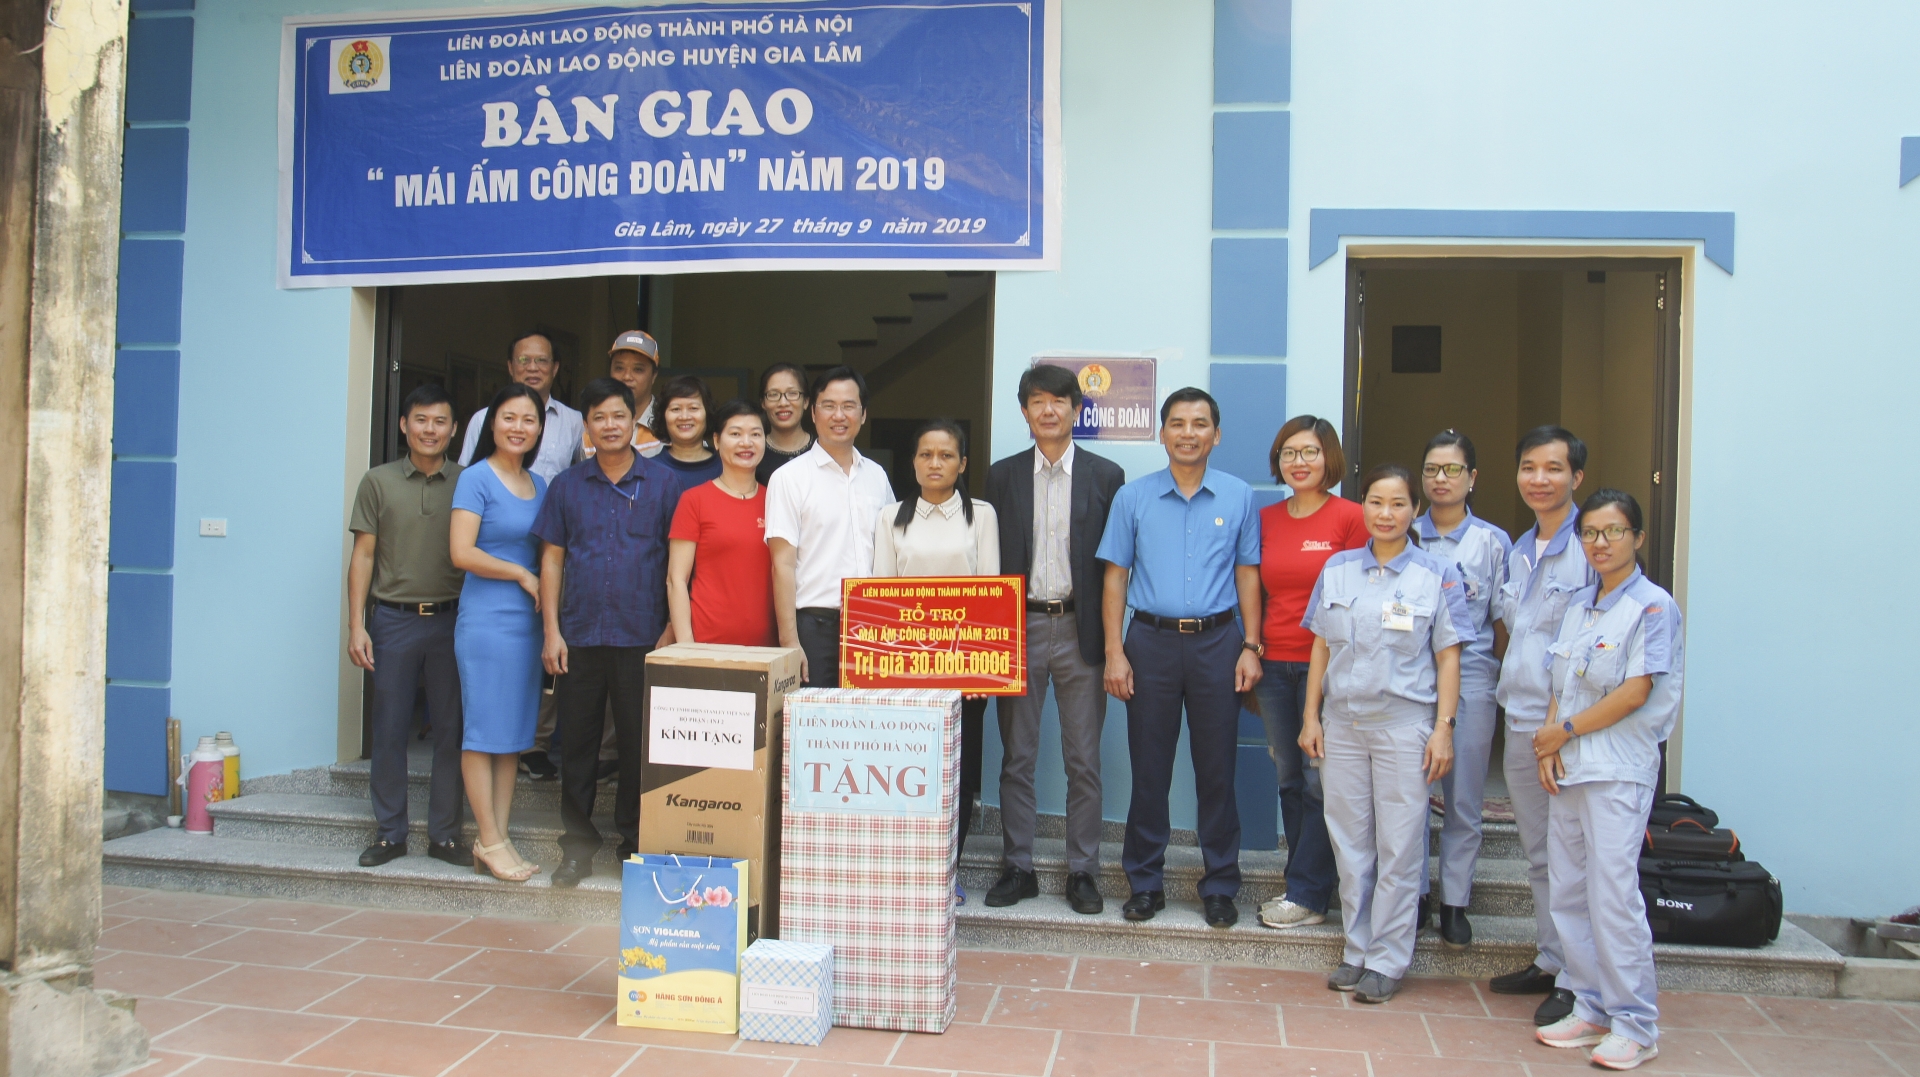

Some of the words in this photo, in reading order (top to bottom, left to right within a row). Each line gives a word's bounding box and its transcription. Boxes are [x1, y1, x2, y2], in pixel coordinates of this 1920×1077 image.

[448, 34, 484, 52] LIÊN
[489, 29, 545, 48] ĐOÀN
[551, 28, 588, 44] LAO
[594, 22, 652, 44] ĐỘNG
[658, 18, 725, 37] THÀNH
[732, 13, 774, 34] PHỐ
[780, 14, 809, 34] HÀ
[816, 14, 852, 36] NỘI
[440, 60, 481, 81] LIÊN
[488, 54, 552, 78] ĐOÀN
[559, 54, 600, 73] LAO
[608, 47, 676, 72] ĐỘNG
[683, 44, 756, 68] HUYỆN
[764, 46, 806, 64] GIA
[814, 41, 862, 63] LÂM
[482, 84, 620, 148] BÀN
[638, 88, 814, 138] GIAO
[395, 166, 456, 208] MÁI
[466, 158, 518, 204] ẤM
[530, 159, 618, 200] CÔNG
[758, 150, 843, 192] NĂM
[856, 157, 945, 191] 2019
[614, 222, 646, 238] Gia
[651, 220, 695, 240] Lâm,
[702, 218, 752, 236] ngày
[755, 218, 783, 234] 27
[792, 218, 853, 236] tháng
[857, 218, 872, 234] 9
[882, 218, 927, 234] năm
[932, 218, 986, 234] 2019
[1084, 402, 1115, 428] CÔNG
[1118, 404, 1150, 428] ĐOÀN
[862, 586, 878, 598] LIÊN
[880, 586, 900, 598] ĐOÀN
[901, 588, 914, 597] LAO
[916, 586, 936, 598] ĐỘNG
[937, 585, 960, 597] THÀNH
[962, 584, 976, 597] PHỐ
[978, 586, 988, 596] HÀ
[990, 586, 1002, 598] NỘI
[899, 603, 925, 622] HỖ
[930, 606, 966, 624] TRỢ
[858, 626, 878, 641] MÁI
[880, 624, 896, 641] ẤM
[900, 626, 926, 641] CÔNG
[929, 626, 956, 641] ĐOÀN
[959, 626, 982, 640] NĂM
[984, 628, 1009, 640] 2019
[854, 652, 874, 680] Trị
[879, 650, 904, 678] giá
[910, 651, 1010, 675] 30.000.000đ
[774, 674, 796, 694] Kangaroo
[799, 715, 827, 728] LIÊN
[870, 720, 897, 730] LAO
[900, 719, 936, 734] ĐỘNG
[662, 726, 697, 741] KÍNH
[702, 730, 742, 746] TẶNG
[806, 737, 850, 750] THÀNH
[854, 740, 880, 751] PHỐ
[884, 740, 900, 752] HÀ
[904, 742, 926, 756] NỘI
[804, 758, 928, 803] TẶNG
[666, 793, 742, 811] Kangaroo
[1656, 898, 1694, 910] SONY
[633, 926, 651, 934] SƠN
[654, 927, 700, 938] VIGLACERA
[656, 992, 676, 1001] HÃNG
[678, 994, 692, 1002] SƠN
